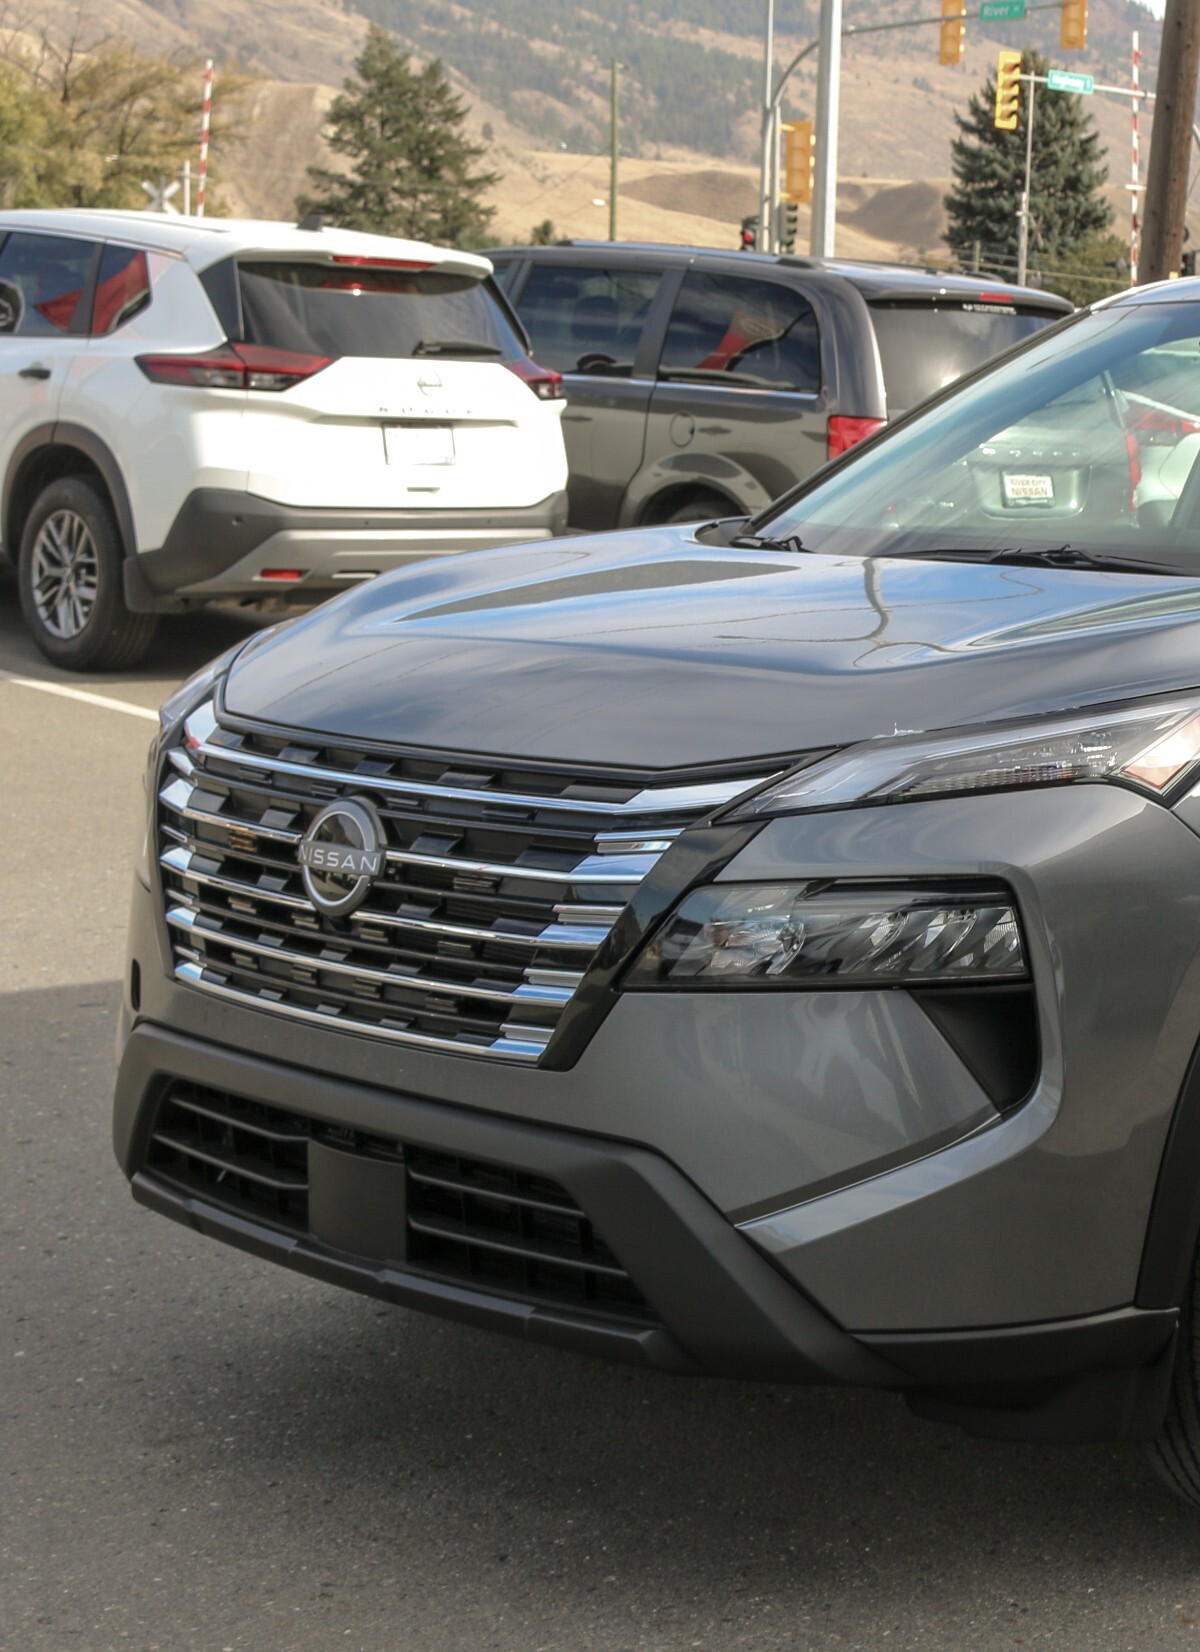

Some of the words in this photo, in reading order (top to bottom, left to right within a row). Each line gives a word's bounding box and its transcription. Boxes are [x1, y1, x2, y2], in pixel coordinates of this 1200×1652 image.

[983, 5, 1010, 17] River
[1011, 487, 1048, 497] NISSAN
[299, 844, 377, 872] NISSAN
